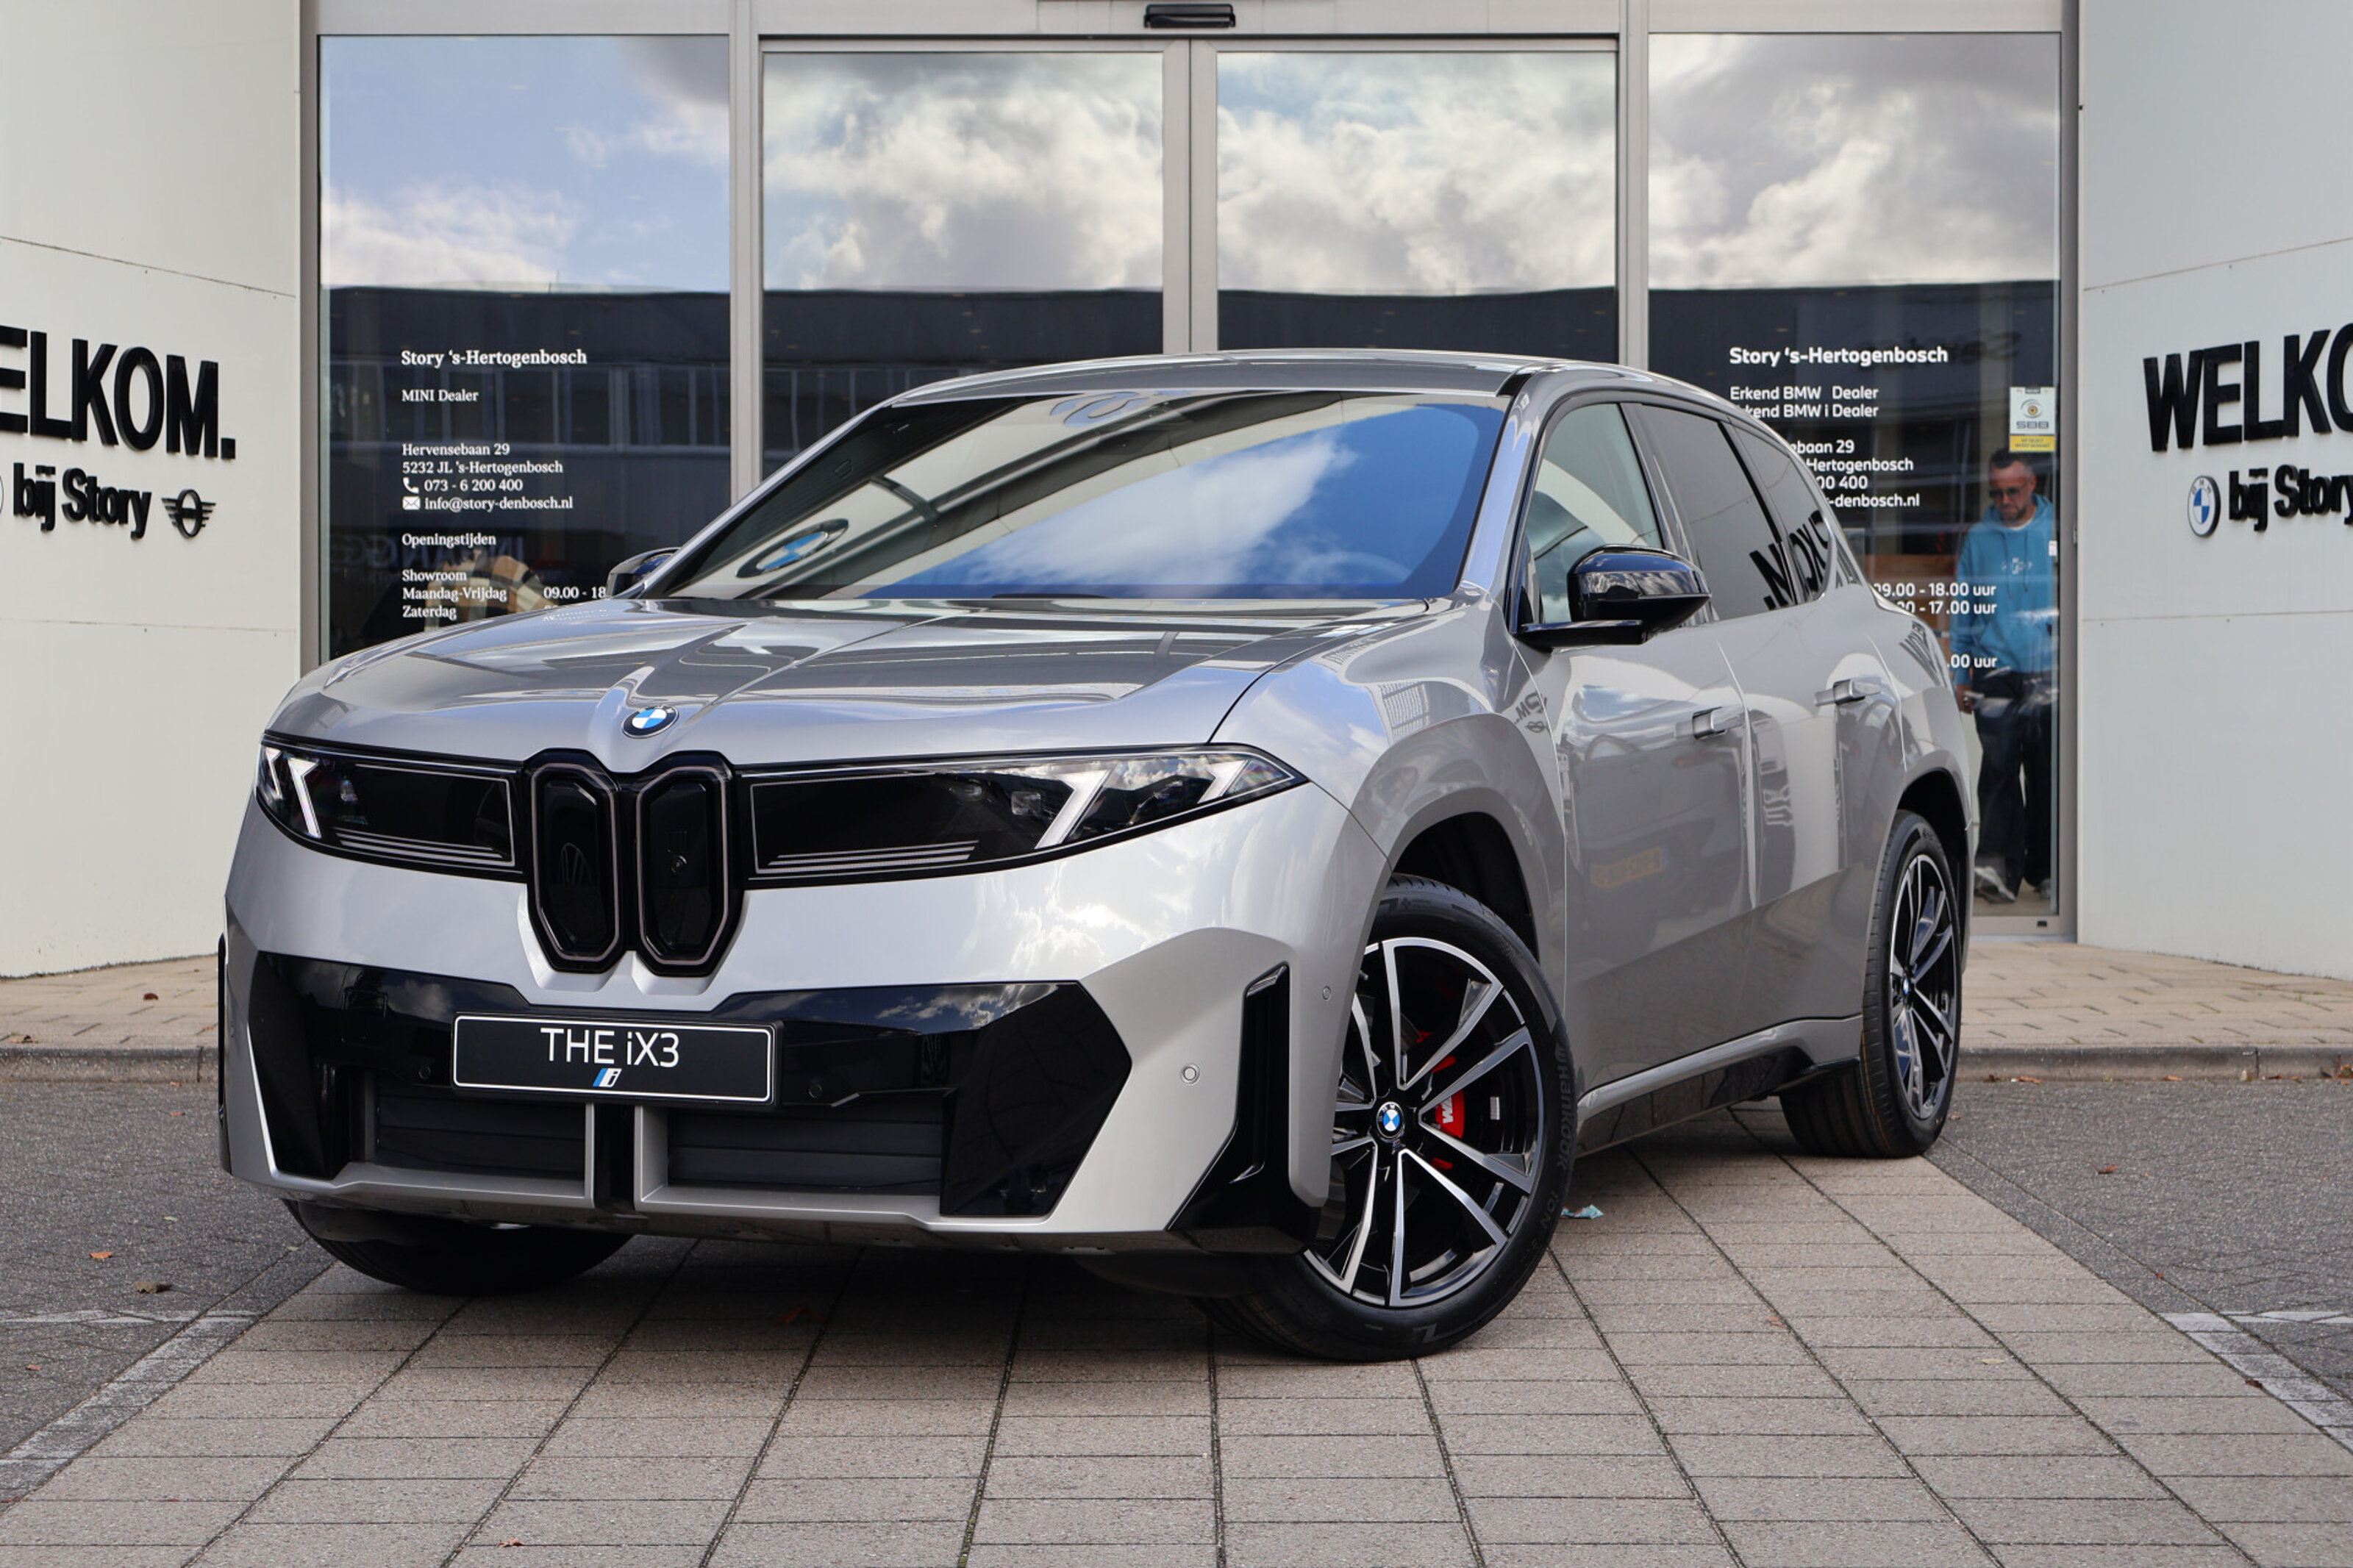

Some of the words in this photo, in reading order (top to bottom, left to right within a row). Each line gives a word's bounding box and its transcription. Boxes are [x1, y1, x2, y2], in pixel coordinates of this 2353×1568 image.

[401, 349, 445, 369] Story
[1729, 347, 1781, 368] Story
[401, 389, 435, 402] MINI
[438, 389, 479, 402] Dealer
[1729, 385, 1780, 400] Erkend
[1783, 385, 1822, 400] BMW
[1832, 385, 1879, 400] Dealer
[1783, 404, 1822, 418] BMW
[1824, 404, 1829, 418] i
[1832, 403, 1879, 418] Dealer
[401, 443, 490, 456] Hervensebaan
[493, 442, 510, 456] 29
[1835, 439, 1855, 454] 29
[401, 461, 434, 474] 5232
[436, 461, 453, 474] JL
[424, 479, 449, 492] 073
[460, 479, 468, 492] 6
[471, 479, 496, 492] 200
[498, 479, 524, 492] 400
[1838, 475, 1868, 490] 400
[13, 462, 56, 532] bij
[61, 468, 152, 540] Story
[424, 495, 574, 512] info@story-denbosch.nl
[2229, 468, 2268, 532] bij
[401, 531, 497, 549] Openingstijden
[401, 568, 468, 582] Showroom
[402, 587, 507, 602] Maandag-Vrijdag
[543, 586, 579, 599] 09.00
[1928, 581, 1970, 597] 18.00
[1973, 585, 1998, 597] uur
[402, 604, 457, 620] Zaterdag
[1974, 603, 1999, 615] uur
[1974, 657, 1999, 668] uur
[540, 1028, 615, 1064] THE
[626, 1032, 680, 1068] iX3
